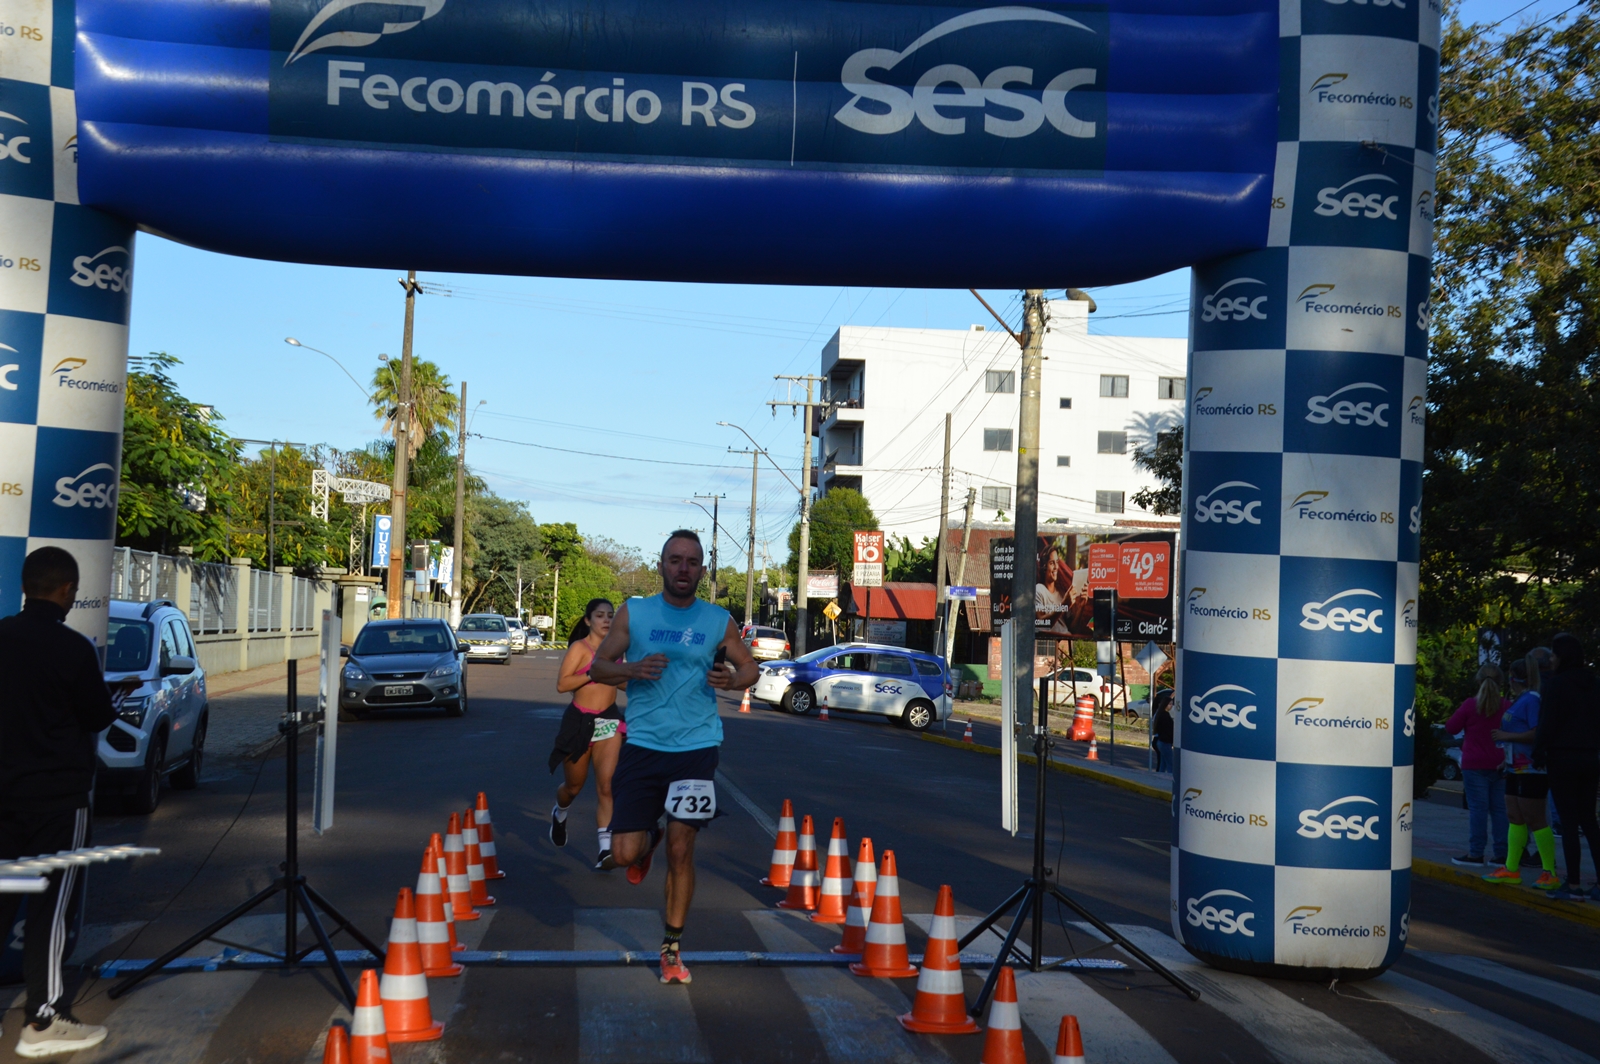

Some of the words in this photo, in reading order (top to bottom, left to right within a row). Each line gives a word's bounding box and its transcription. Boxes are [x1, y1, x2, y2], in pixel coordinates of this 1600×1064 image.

[20, 25, 44, 42] RS
[326, 60, 662, 125] Fecomércio
[682, 81, 757, 129] RS
[833, 46, 1097, 139] Sesc
[1318, 91, 1397, 107] Fecomércio
[1400, 96, 1414, 109] RS
[1313, 187, 1399, 221] Sesc
[19, 257, 41, 272] RS
[1201, 295, 1268, 323] Sesc
[1305, 301, 1384, 317] Fecomércio
[1387, 305, 1401, 318] RS
[58, 374, 118, 394] Fecomércio
[1196, 403, 1254, 416] Fecomércio
[1257, 403, 1277, 416] RS
[1305, 395, 1389, 428] Sesc
[1, 482, 24, 497] RS
[1194, 495, 1261, 525] Sesc
[1299, 508, 1377, 523] Fecomércio
[1380, 512, 1394, 525] RS
[855, 533, 882, 543] Kaiser
[377, 531, 390, 565] URI
[857, 545, 879, 562] 10
[1005, 553, 1014, 563] rápi
[1122, 554, 1130, 566] R$
[1091, 567, 1107, 579] 500
[71, 597, 101, 610] mércio
[1189, 603, 1248, 620] Fecomércio
[1252, 608, 1271, 621] RS
[1299, 601, 1383, 634] Sesc
[1138, 619, 1164, 635] Claro
[874, 682, 903, 695] Sesc
[1188, 695, 1257, 730] Sesc
[1294, 714, 1372, 729] Fecomércio
[1375, 718, 1389, 730] RS
[671, 795, 712, 813] 732
[1185, 803, 1245, 825] Fecomércio
[1249, 813, 1268, 827] RS
[1296, 808, 1379, 841] Sesc
[1186, 897, 1255, 938] Sesc
[1292, 922, 1370, 938] Fecomércio
[1373, 925, 1386, 937] RS
